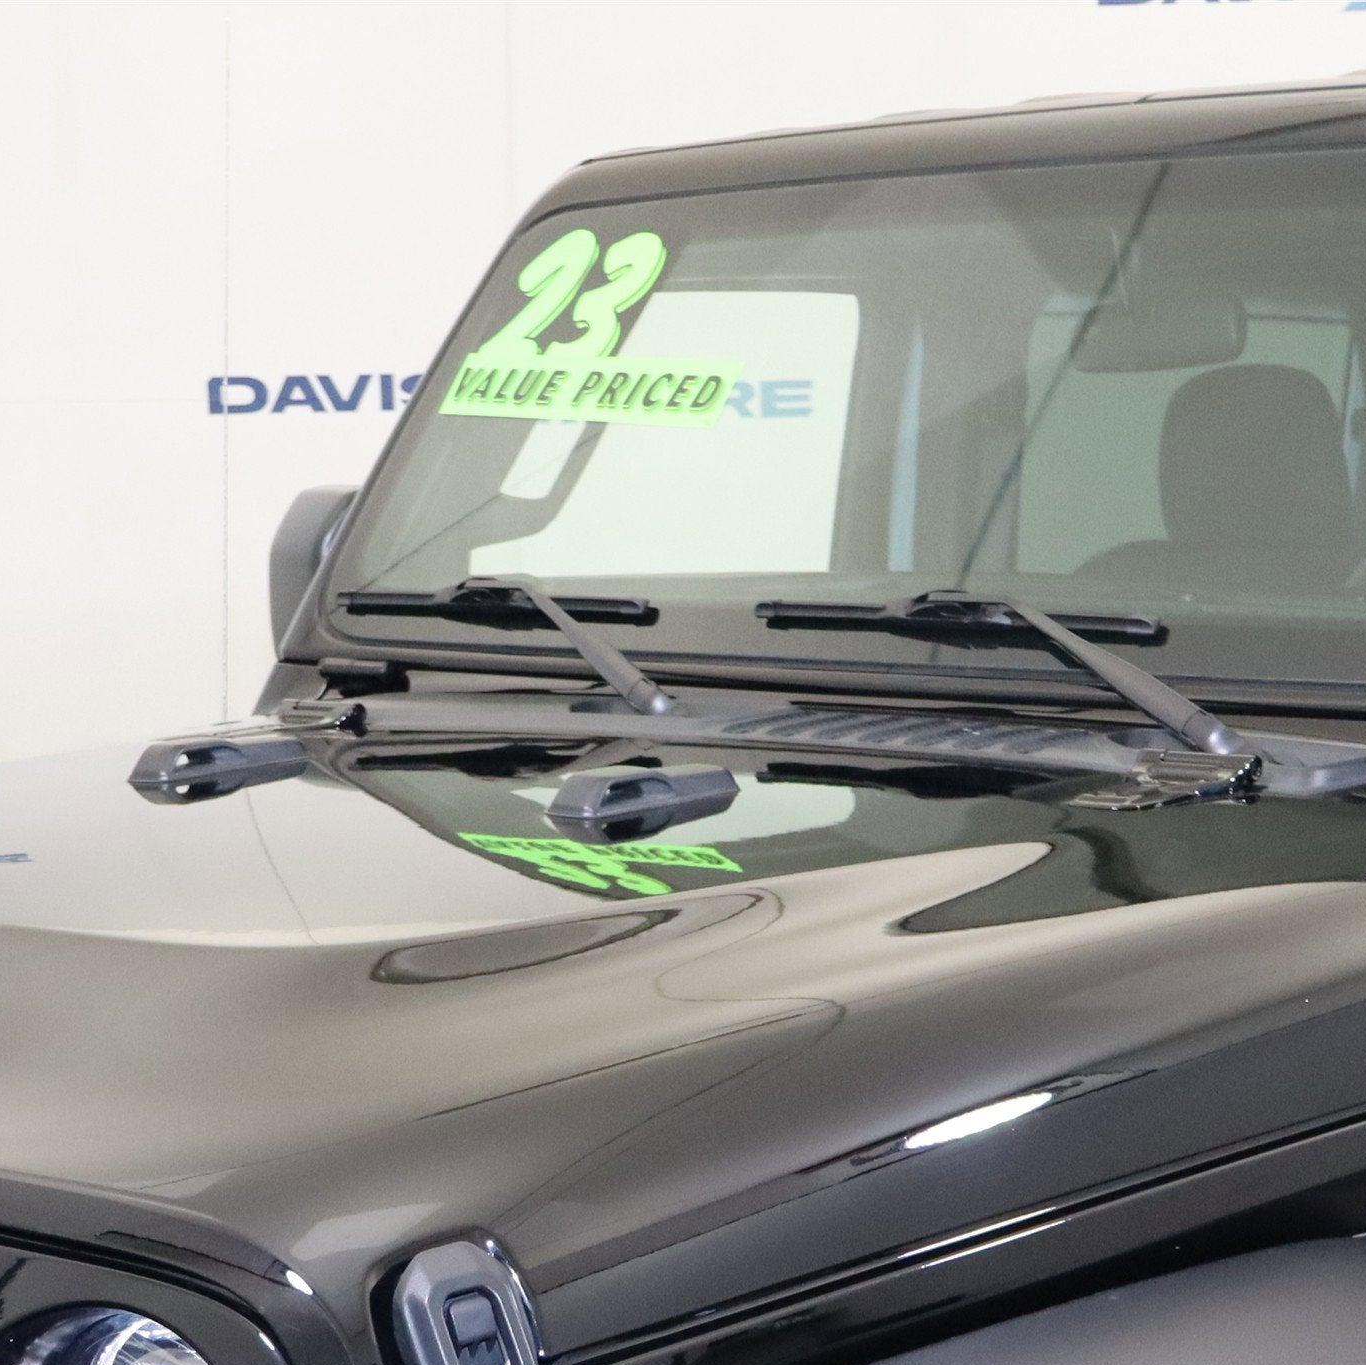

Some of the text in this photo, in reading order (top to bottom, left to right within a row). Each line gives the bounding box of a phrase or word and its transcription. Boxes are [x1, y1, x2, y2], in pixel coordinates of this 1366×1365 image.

[475, 228, 667, 358] 23
[454, 367, 567, 405] VALUE
[572, 370, 724, 412] PRICED
